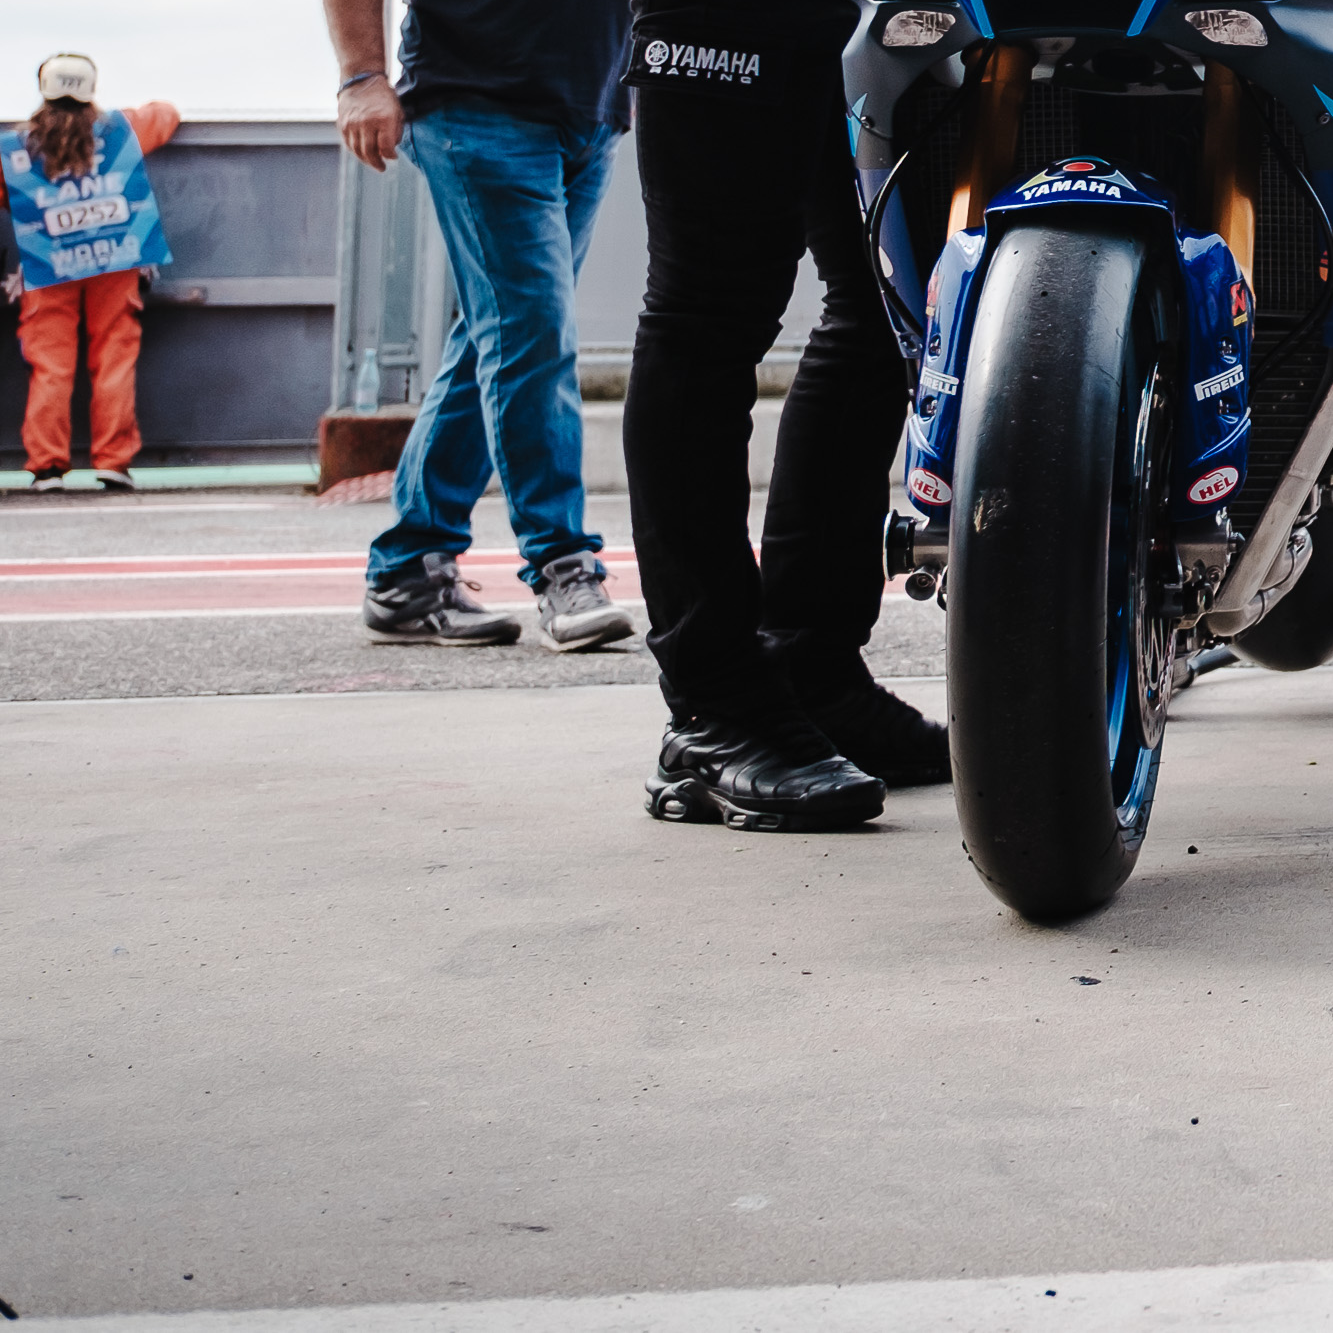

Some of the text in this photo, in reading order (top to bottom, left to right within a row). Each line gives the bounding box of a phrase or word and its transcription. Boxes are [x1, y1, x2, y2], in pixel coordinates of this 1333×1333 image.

[671, 43, 760, 77] YAMAHA
[649, 66, 752, 84] RACING
[35, 170, 125, 209] LANE
[1022, 179, 1122, 201] YAMAHA
[57, 200, 120, 229] 0252
[919, 365, 960, 396] PIRELLI
[1194, 364, 1245, 402] PIRELLI
[913, 477, 943, 502] HEL
[1198, 473, 1235, 501] HEL
